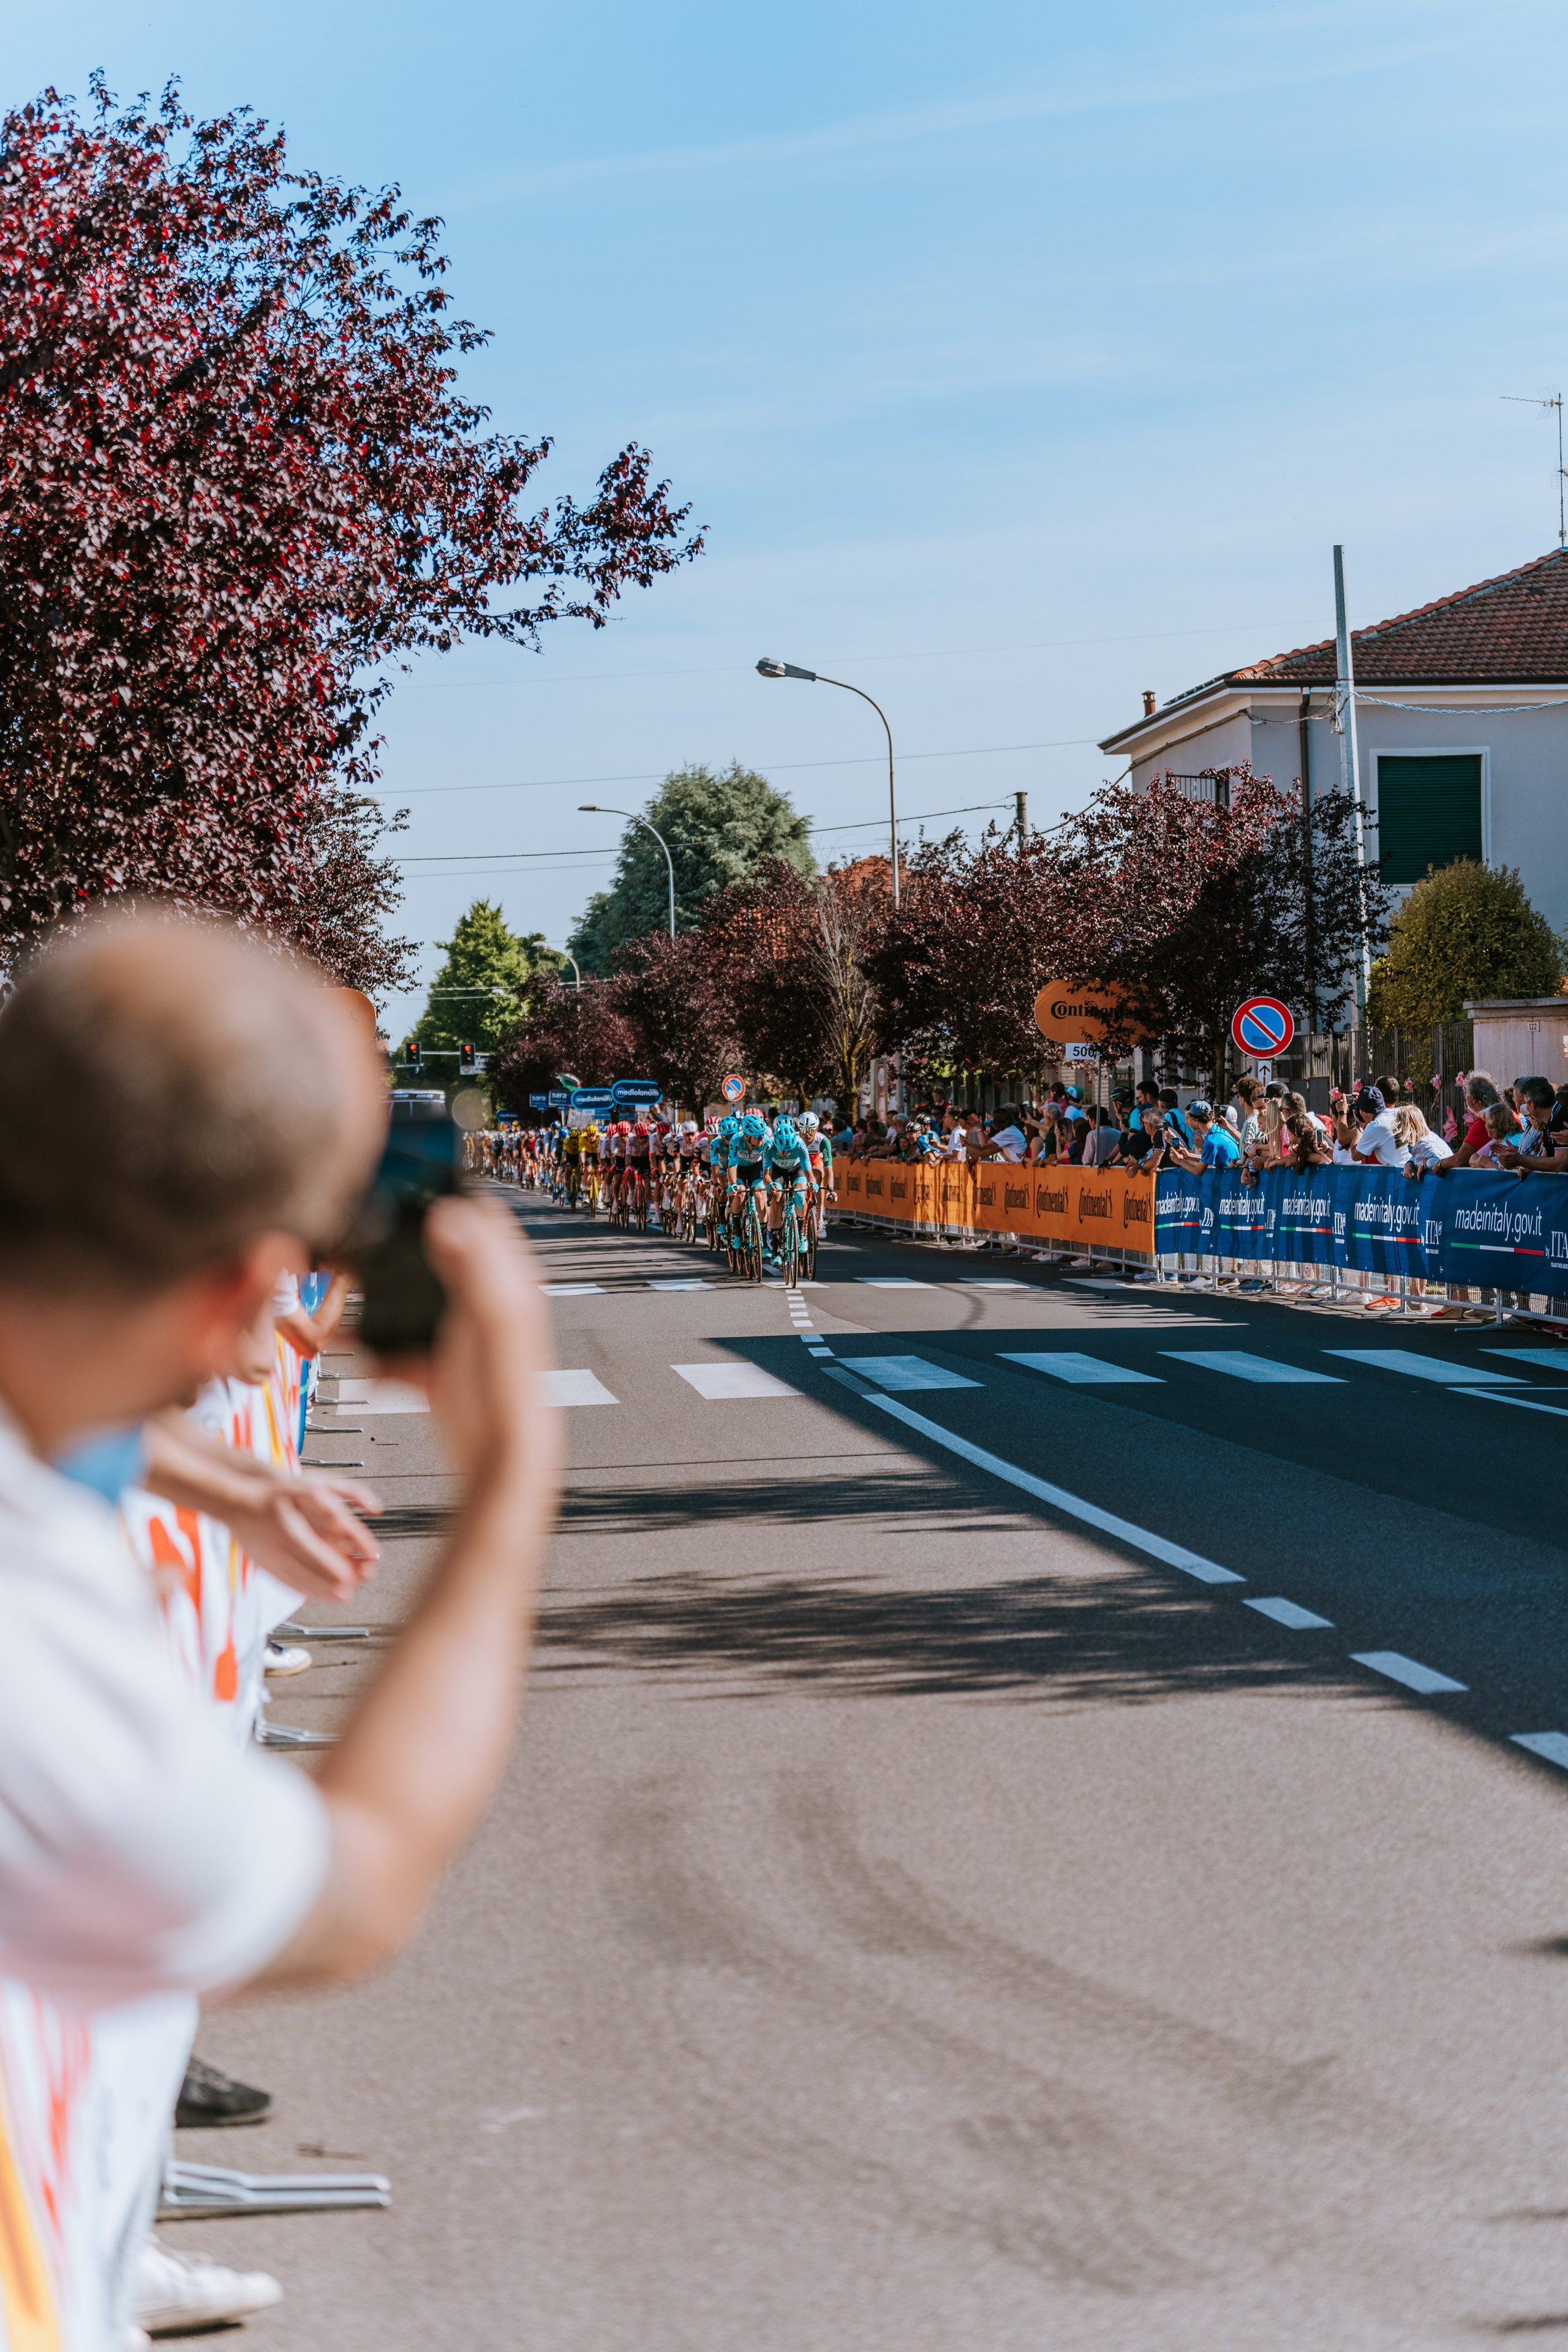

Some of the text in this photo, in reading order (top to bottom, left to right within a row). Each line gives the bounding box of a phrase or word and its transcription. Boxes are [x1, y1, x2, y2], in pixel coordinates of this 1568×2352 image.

[1073, 1046, 1095, 1057] 500
[1036, 1183, 1068, 1218] Continental
[1079, 1187, 1112, 1224] Continental
[1123, 1189, 1152, 1229] Continental
[1219, 1191, 1265, 1223] madeinitaly.gov.it
[1282, 1189, 1330, 1224] madeinitaly.gov.it
[1354, 1194, 1420, 1232] madeinitaly.gov.it
[1455, 1200, 1542, 1243] madeinitaly.gov.it
[1545, 1231, 1568, 1259] by ITA
